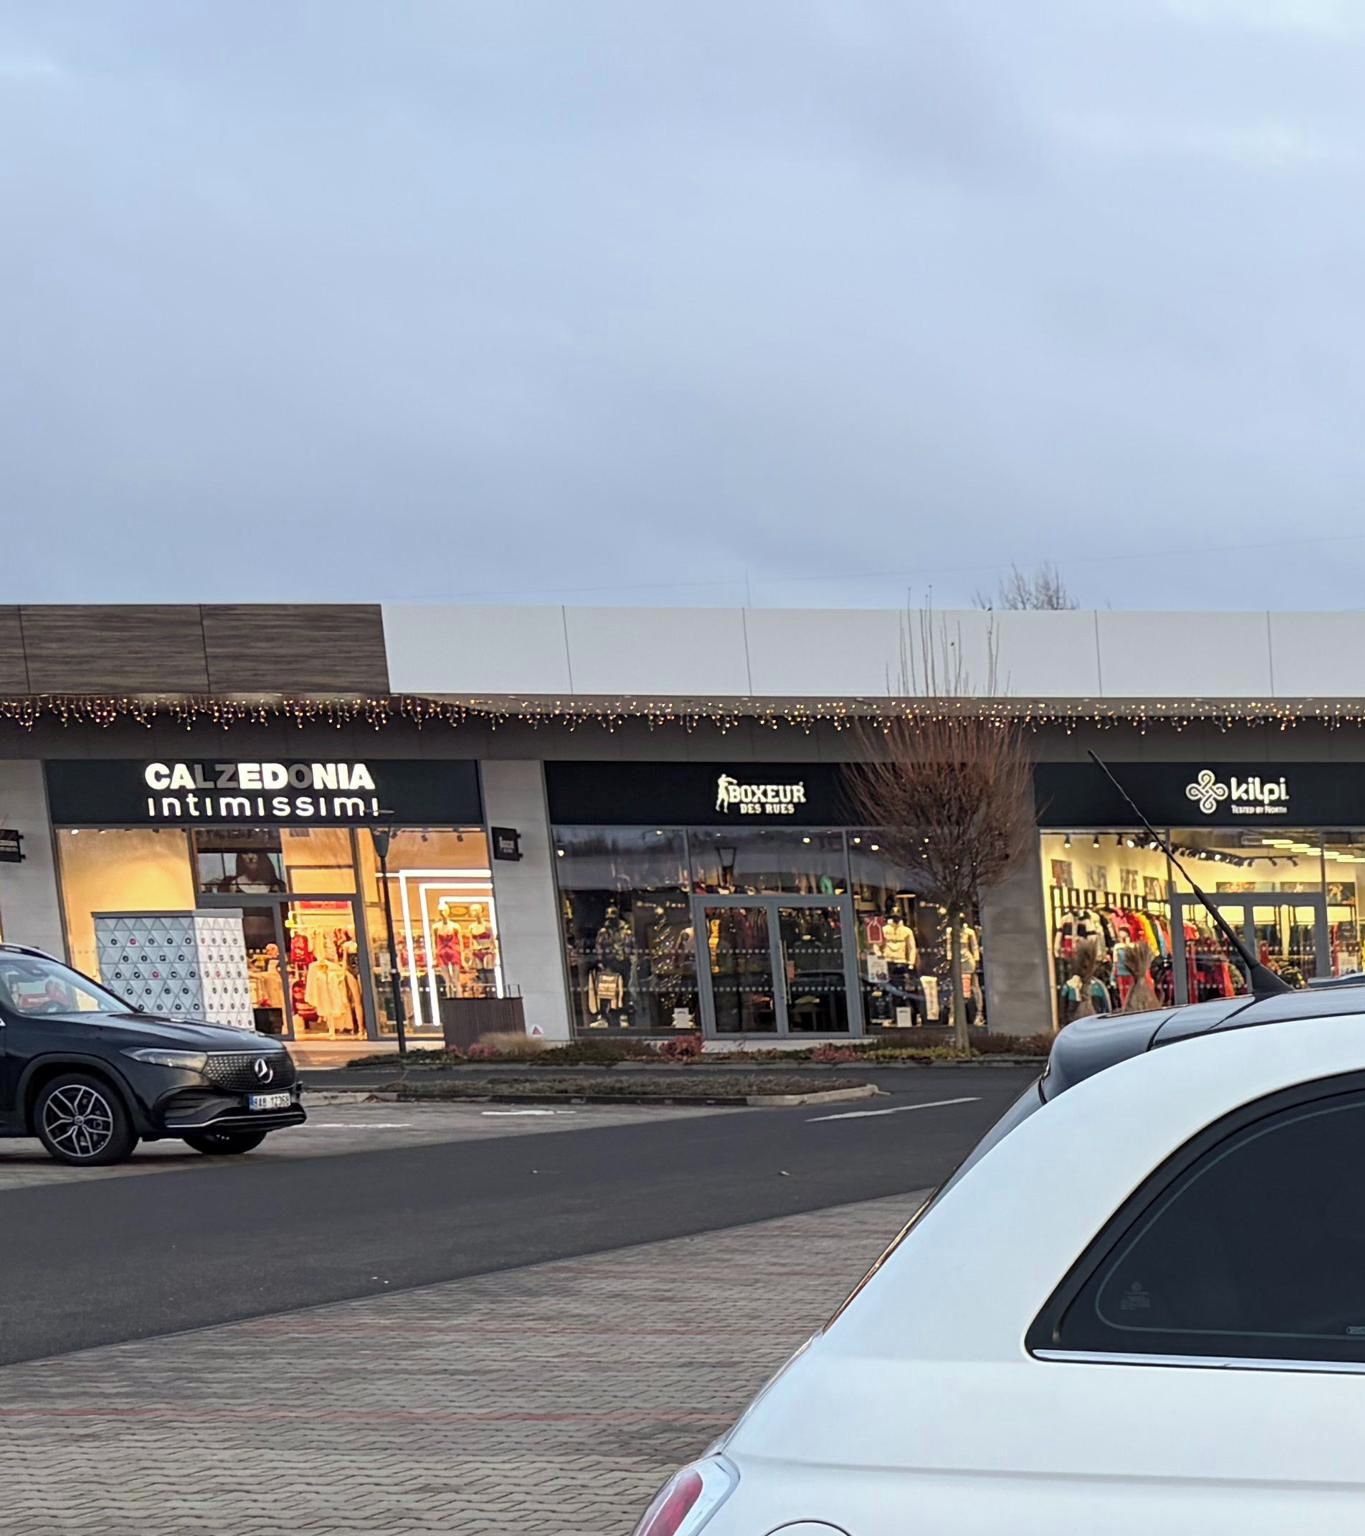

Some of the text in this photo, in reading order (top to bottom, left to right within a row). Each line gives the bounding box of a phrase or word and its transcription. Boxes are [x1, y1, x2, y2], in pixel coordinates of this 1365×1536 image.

[145, 763, 376, 790] CALZEDONIA
[728, 785, 807, 803] BOXEUR
[1230, 777, 1287, 804] kilpi
[148, 793, 379, 817] intimissimi
[740, 803, 795, 814] DES RUES
